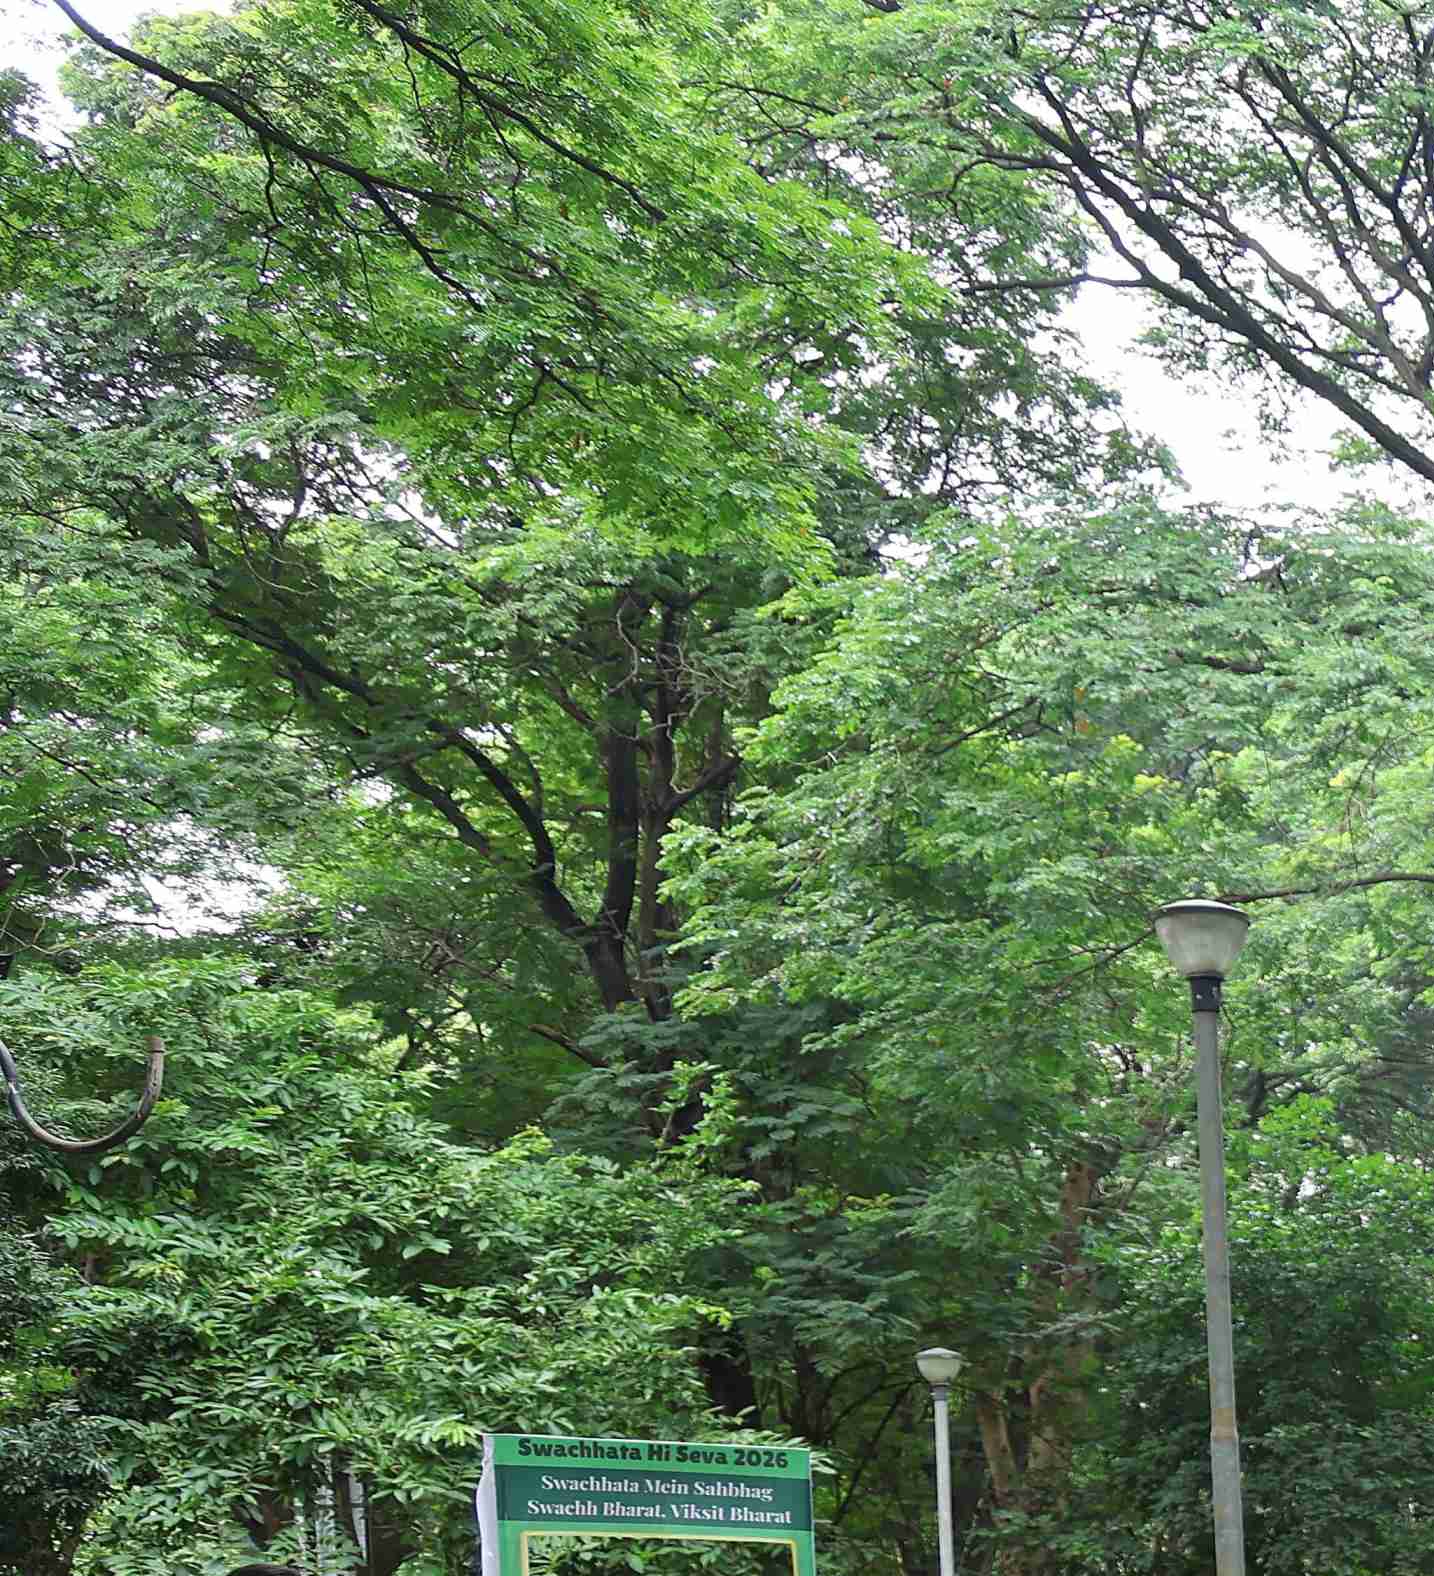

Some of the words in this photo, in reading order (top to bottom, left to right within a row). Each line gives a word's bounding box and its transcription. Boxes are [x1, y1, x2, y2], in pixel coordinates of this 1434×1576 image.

[518, 1439, 642, 1461] Swachhata
[649, 1445, 671, 1462] Hi
[676, 1446, 728, 1466] Seva
[734, 1449, 788, 1469] 2026
[541, 1475, 640, 1493] Swachhata
[645, 1479, 689, 1495] Mein
[694, 1481, 774, 1501] Sahbhag
[528, 1500, 597, 1516] Swachh
[671, 1504, 724, 1521] Viksit
[730, 1507, 792, 1524] Bharat
